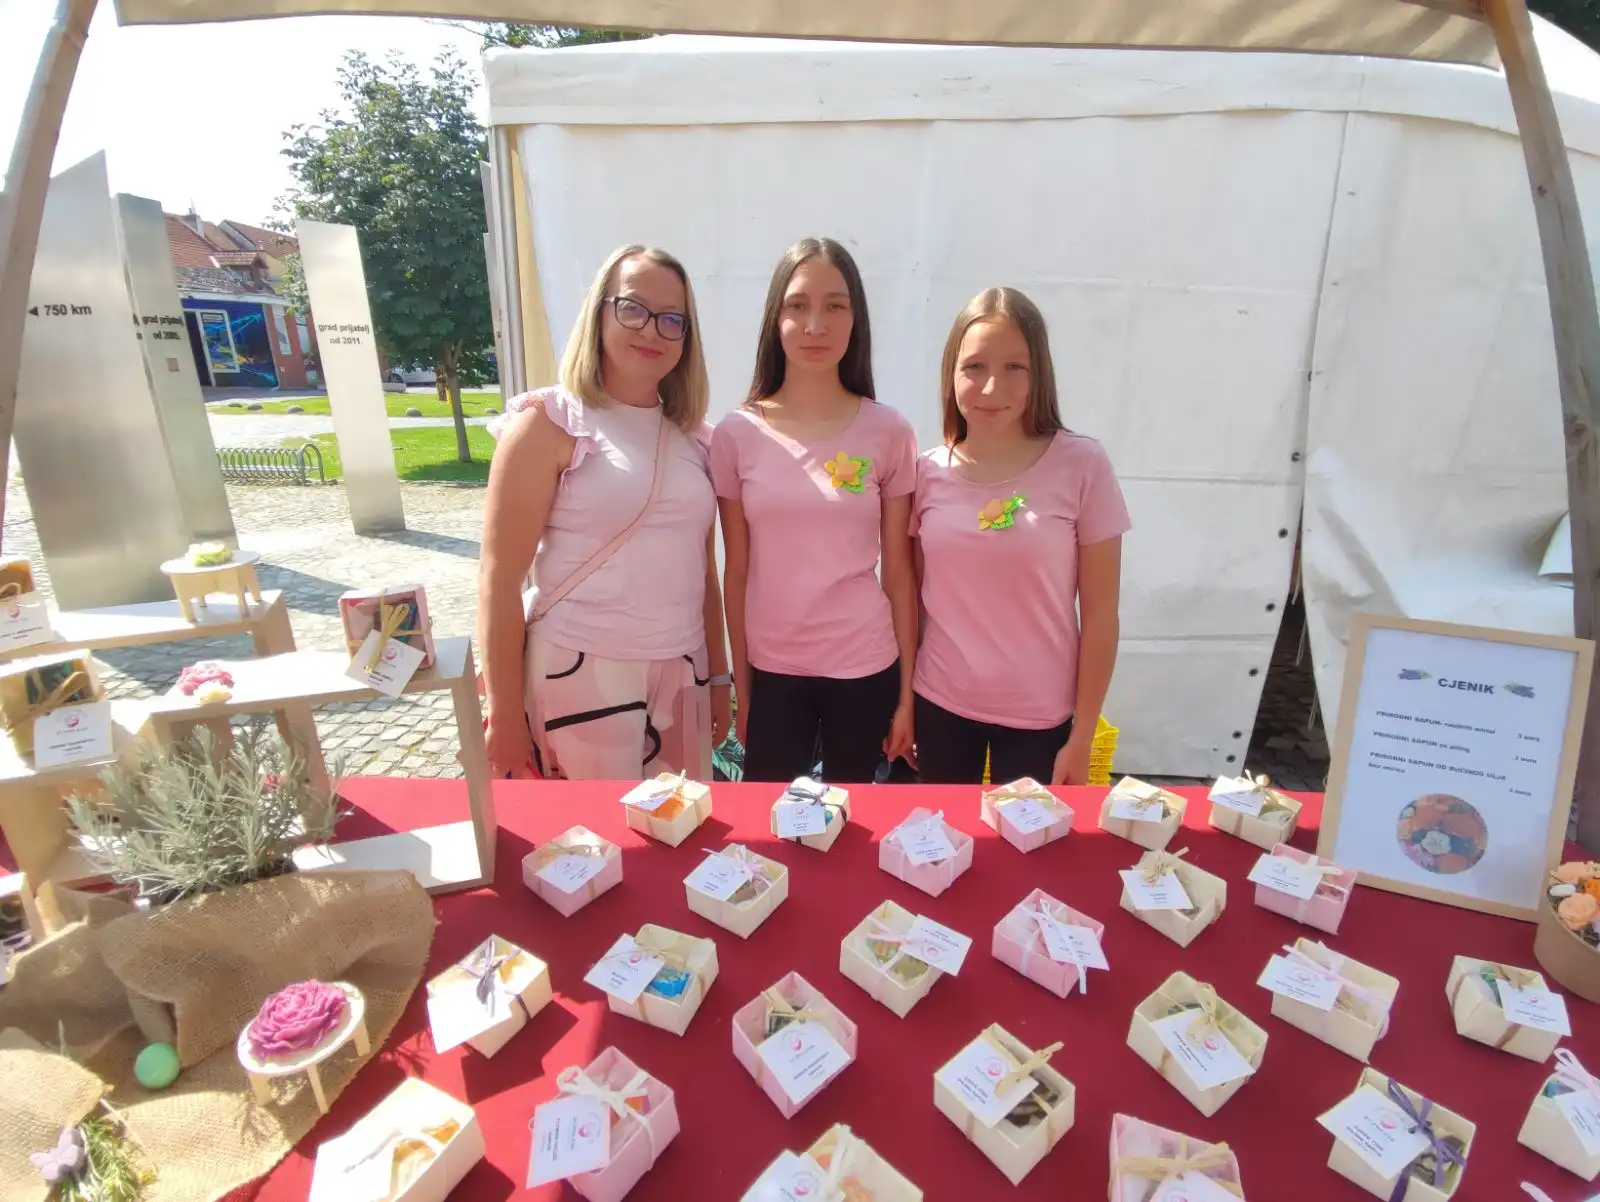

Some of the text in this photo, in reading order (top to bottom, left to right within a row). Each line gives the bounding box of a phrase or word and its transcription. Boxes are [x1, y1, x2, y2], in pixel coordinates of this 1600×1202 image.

[43, 303, 92, 316] 750 km
[142, 314, 158, 325] grad
[318, 323, 370, 334] grad prijatelj
[342, 337, 364, 345] 2011.
[1437, 678, 1495, 694] CJENIK
[1376, 710, 1412, 721] PRIRODNI
[1373, 731, 1409, 742] PRIRODNI
[1411, 738, 1437, 748] SAPUN
[1370, 751, 1406, 763] PRIRODNI
[1408, 758, 1434, 768] SAPUN
